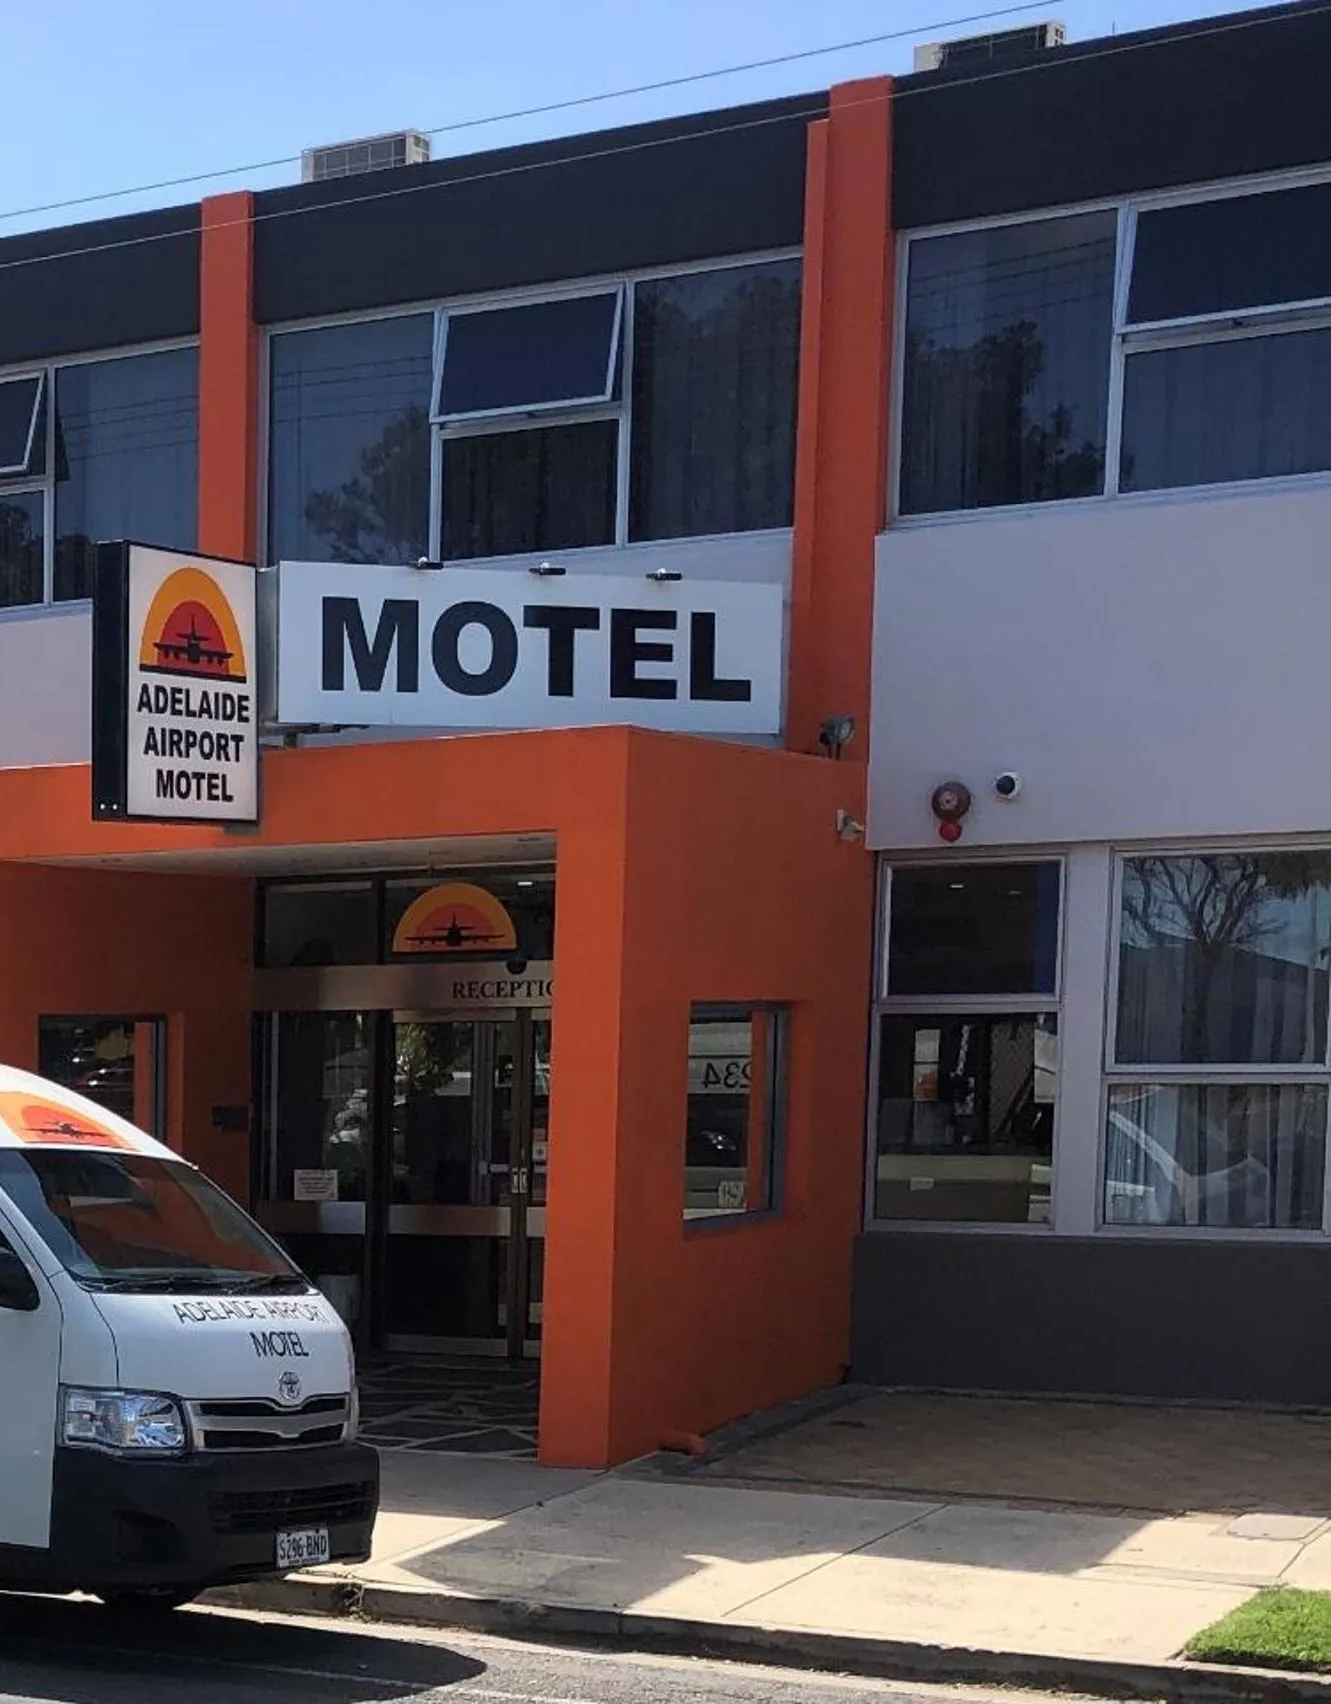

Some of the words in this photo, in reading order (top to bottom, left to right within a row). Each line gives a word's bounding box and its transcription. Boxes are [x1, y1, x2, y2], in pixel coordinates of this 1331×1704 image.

[321, 596, 752, 703] MOTEL
[137, 683, 250, 723] ADELAIDE
[143, 726, 245, 762] AIRPORT
[156, 768, 234, 802] MOTEL
[171, 1300, 266, 1324] ADELAIDE
[262, 1301, 330, 1324] AIRPORT
[248, 1331, 310, 1358] MOTEL
